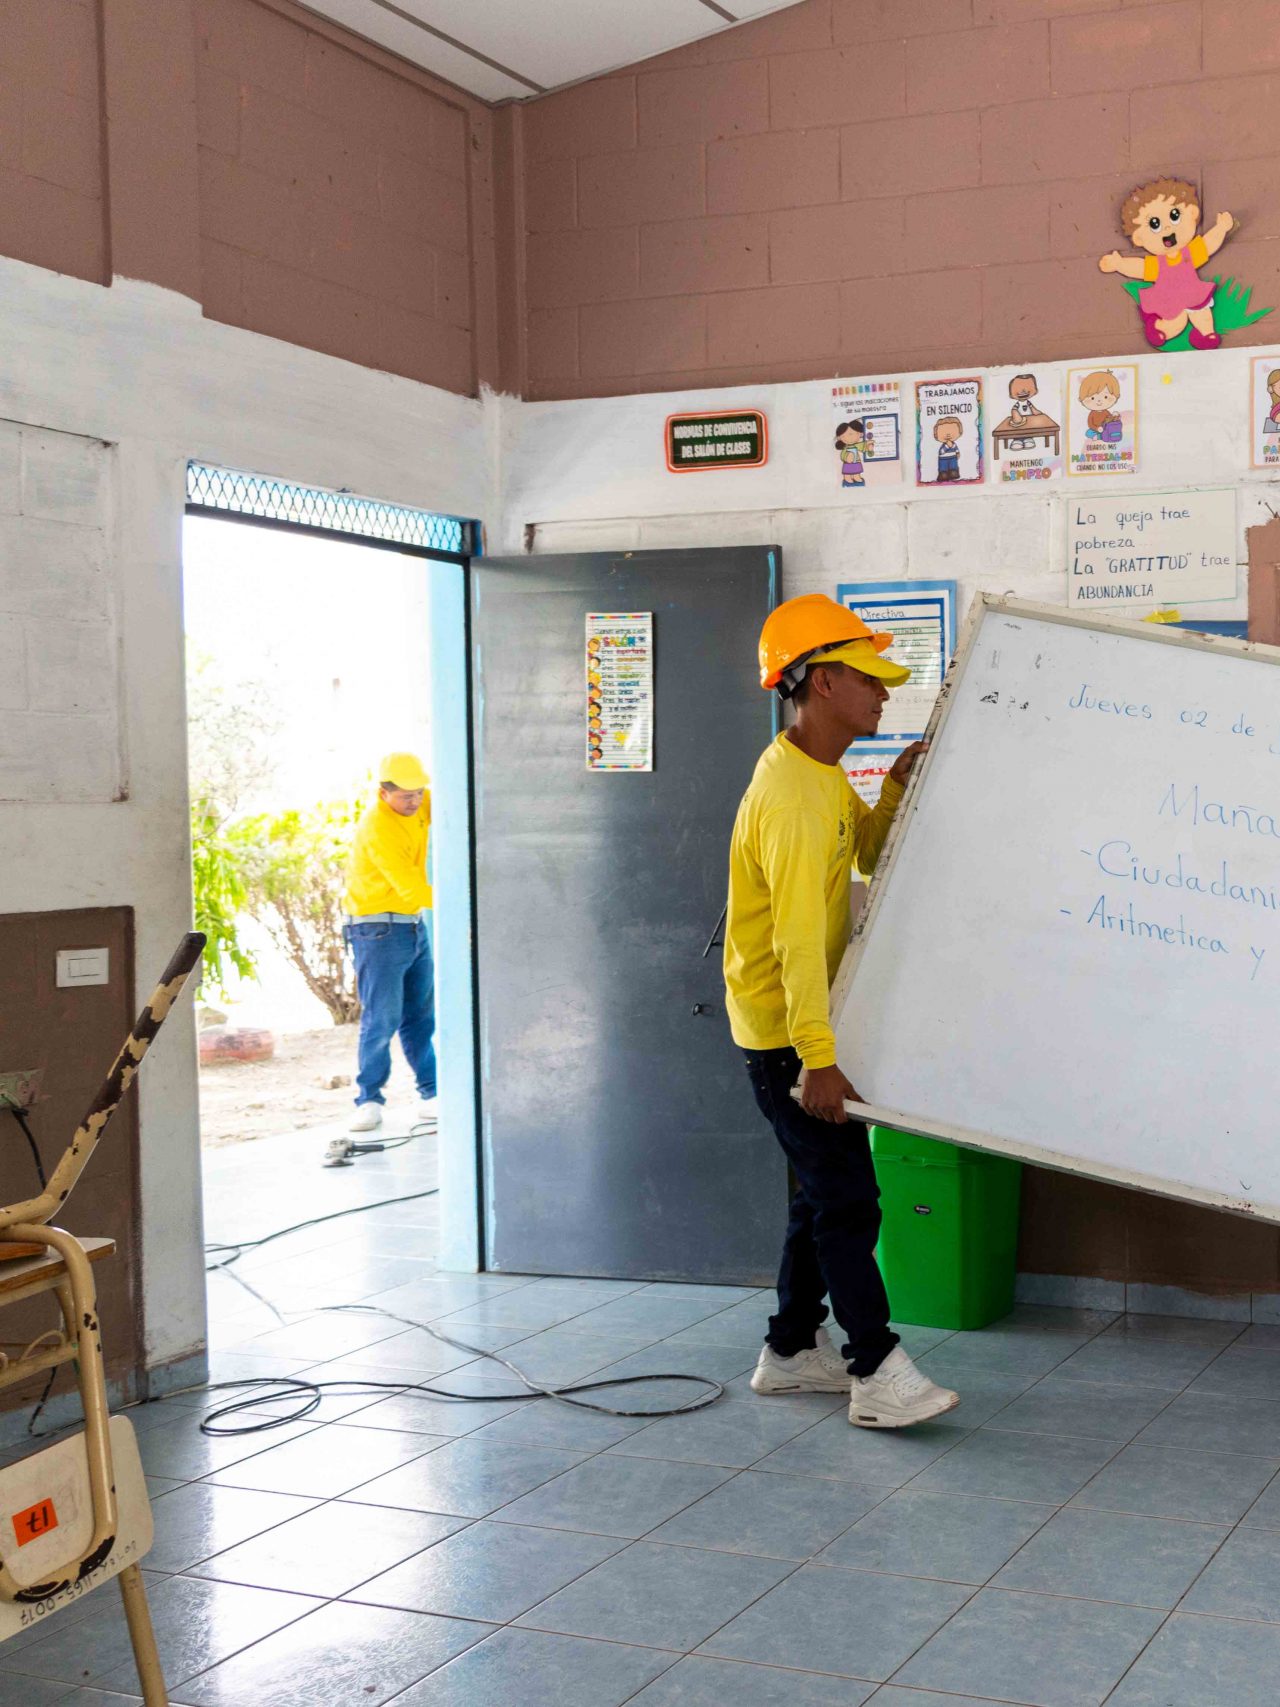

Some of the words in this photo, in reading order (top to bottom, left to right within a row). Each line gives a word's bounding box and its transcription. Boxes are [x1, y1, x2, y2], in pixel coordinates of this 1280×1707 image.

[925, 387, 975, 398] TRABAJAMOS
[927, 406, 936, 416] EN
[938, 403, 973, 415] SILENCIO
[704, 424, 713, 437] DE
[714, 420, 757, 436] CONVIVENCIA
[682, 445, 693, 458] DEL
[716, 443, 725, 456] DE
[726, 441, 751, 455] CLASES
[1071, 452, 1132, 462] MATERIALES
[1010, 458, 1043, 468] MANTENGO
[1002, 467, 1052, 481] LIMPIO
[1076, 507, 1096, 525] La
[1116, 511, 1153, 532] queja
[1160, 506, 1190, 520] trae
[1075, 536, 1135, 554] pobreza
[1074, 557, 1094, 575] La
[1201, 552, 1230, 567] trae
[1077, 583, 1154, 600] ABUNDANCIA
[860, 607, 905, 620] Directiva
[1068, 684, 1152, 719] Jueves
[1180, 711, 1207, 727] 02
[1231, 713, 1255, 737] de
